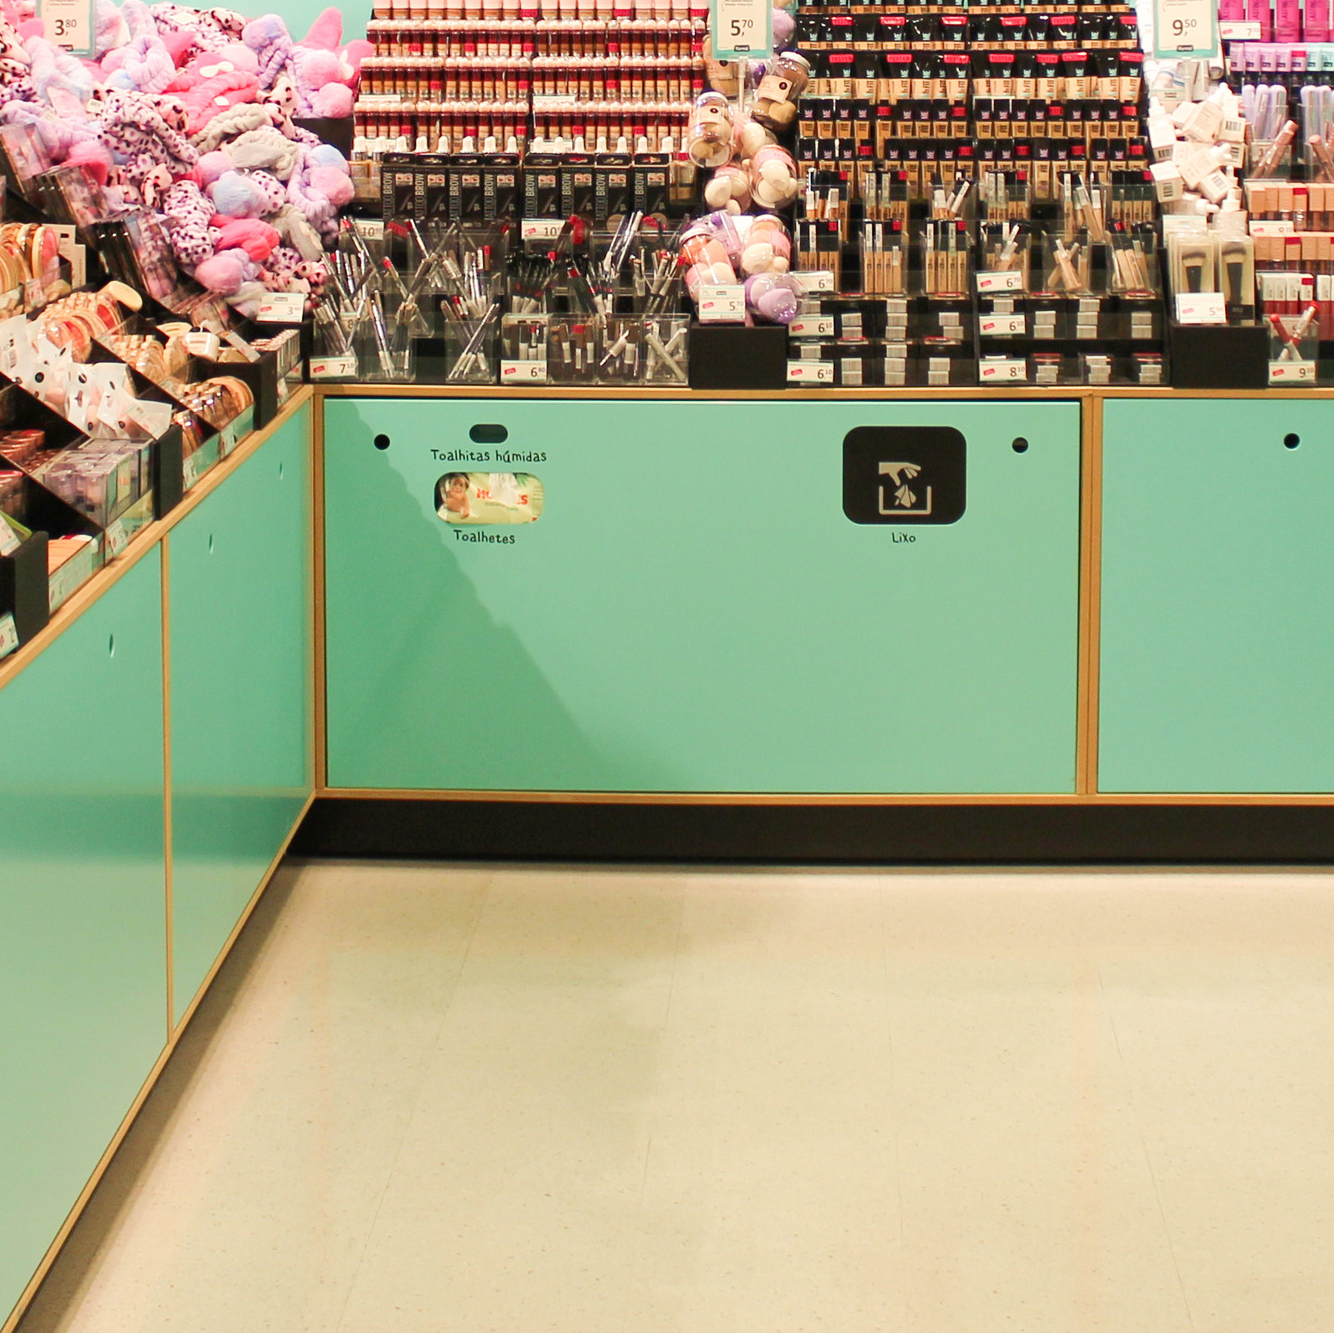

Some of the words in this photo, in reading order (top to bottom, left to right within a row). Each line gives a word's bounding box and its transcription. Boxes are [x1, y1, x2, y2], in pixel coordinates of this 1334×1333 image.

[430, 449, 491, 463] Toalhitas
[495, 447, 547, 463] húmidas
[453, 529, 516, 545] Toalhetes
[892, 530, 916, 544] Lixo
